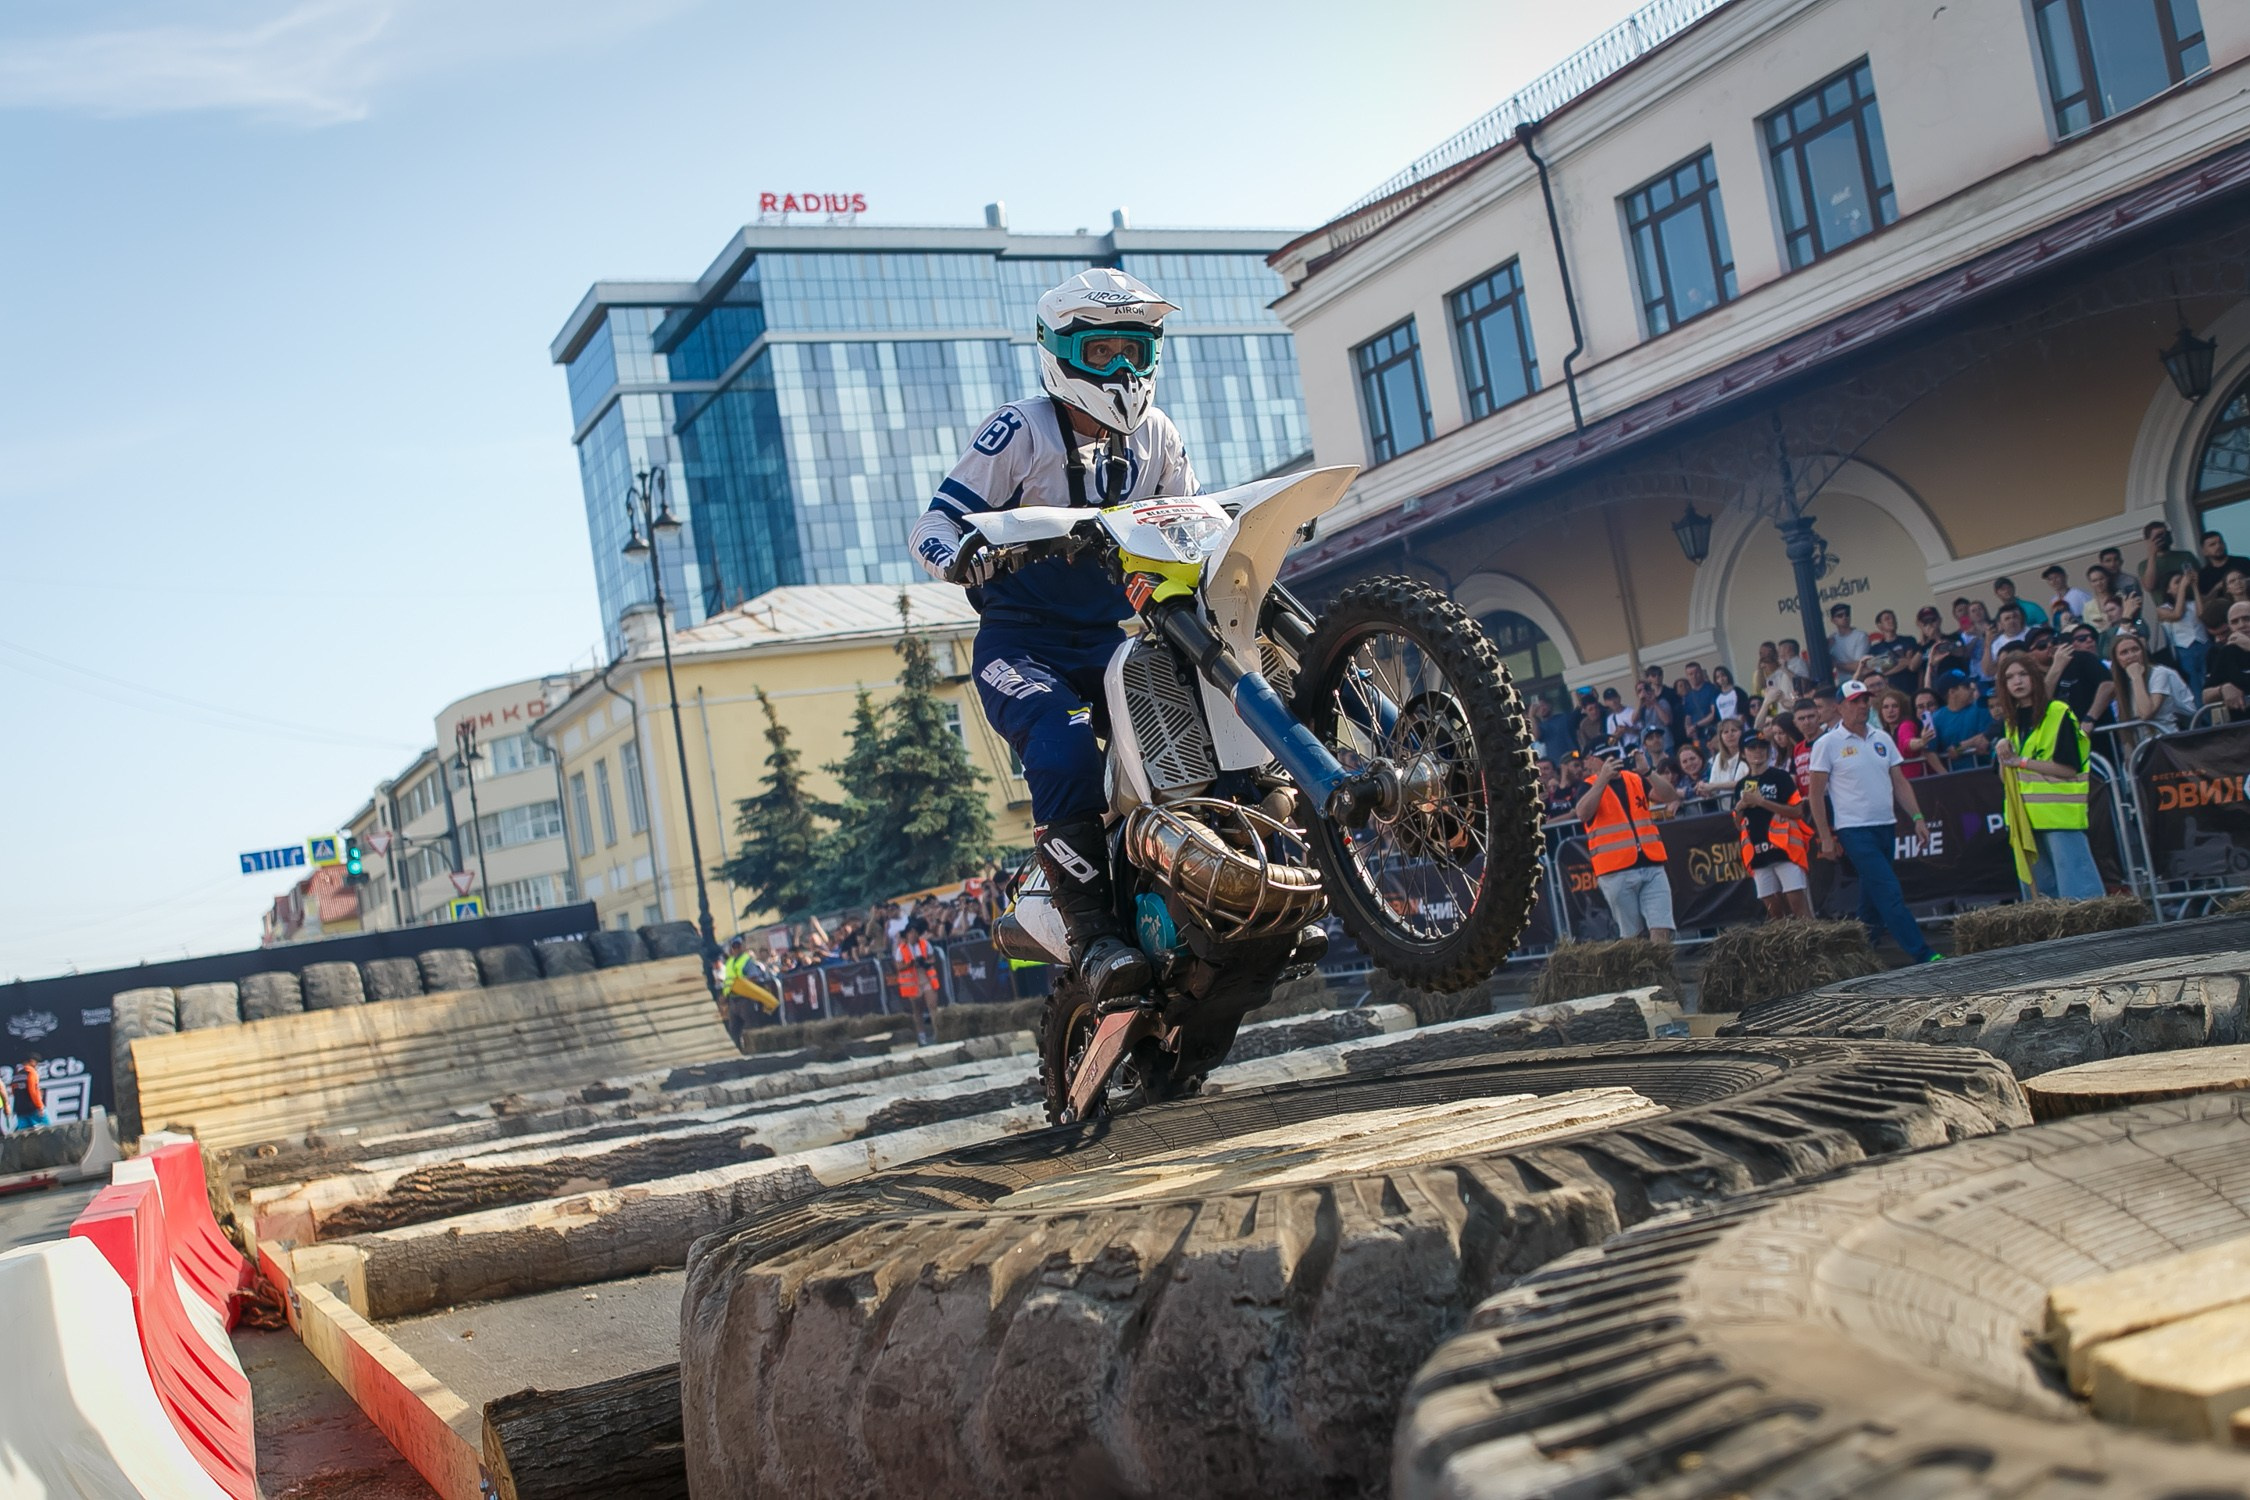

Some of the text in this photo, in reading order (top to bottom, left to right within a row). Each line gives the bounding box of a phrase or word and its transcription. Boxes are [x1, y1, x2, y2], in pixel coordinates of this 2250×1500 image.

[759, 192, 868, 213] RADIUS
[1114, 306, 1145, 316] AIROH
[1711, 843, 1743, 864] SIM
[1714, 865, 1752, 883] LAN
